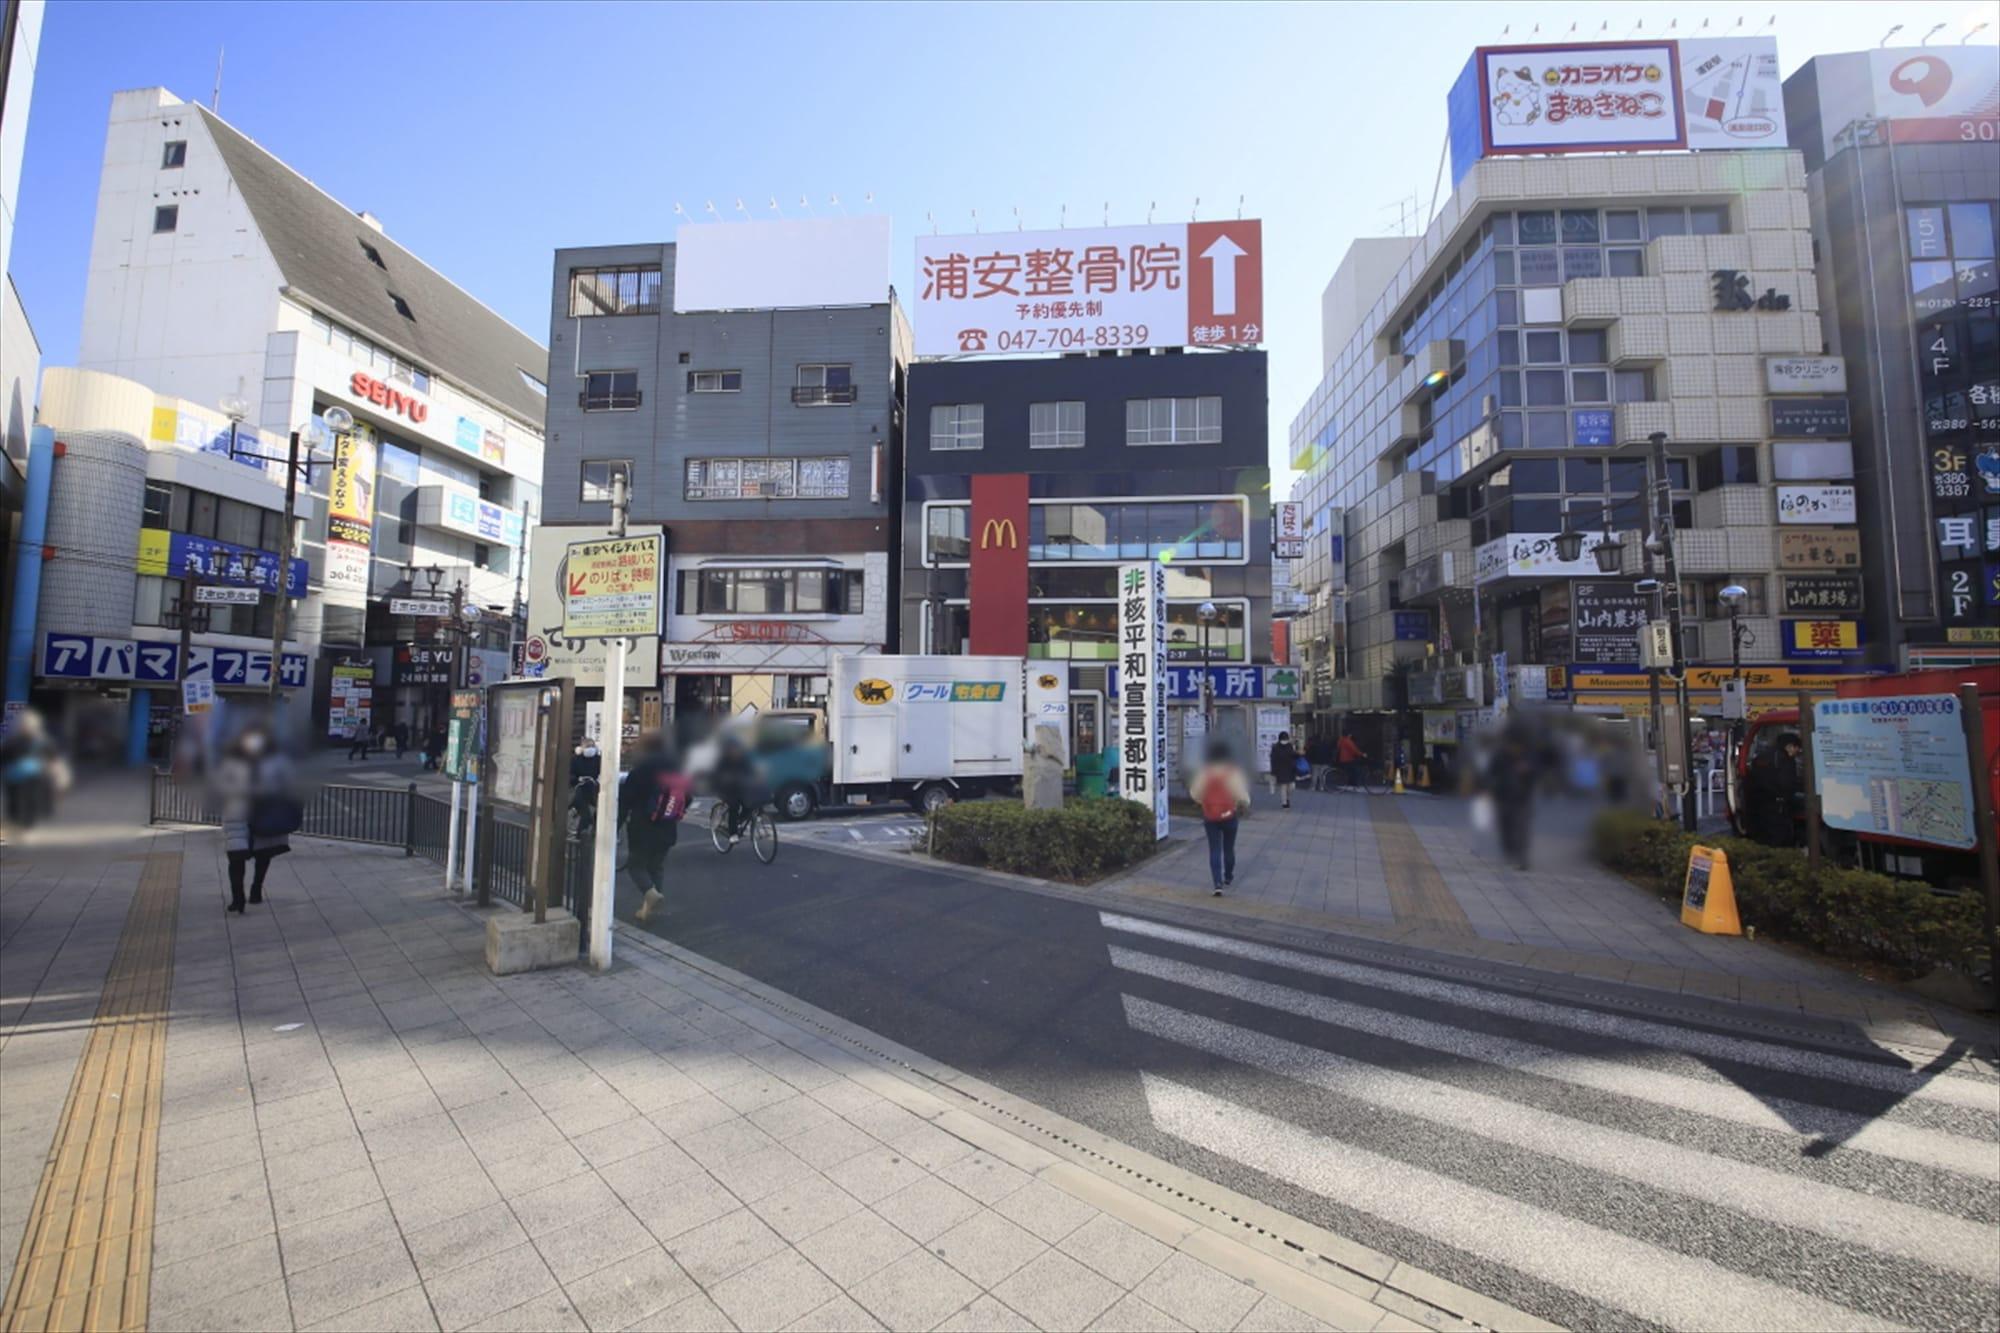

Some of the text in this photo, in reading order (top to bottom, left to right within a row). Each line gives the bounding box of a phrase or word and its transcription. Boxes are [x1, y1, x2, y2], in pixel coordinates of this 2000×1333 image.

[1559, 65, 1644, 84] カラオケ
[1547, 92, 1664, 124] まねきねこ
[922, 242, 1181, 301] 浦安整骨院
[1016, 300, 1103, 320] 予約優先制
[998, 325, 1148, 351] 047-704-8339
[1193, 326, 1260, 342] 徒歩1分
[350, 372, 428, 423] SEIYU
[1934, 450, 1967, 471] 3F
[1936, 485, 1970, 496] 3387
[1952, 571, 1972, 616] 2F
[732, 622, 787, 640] SLOT
[1810, 623, 1841, 646] 薬
[52, 640, 305, 684] アパマンプラザ
[411, 651, 453, 663] SEYU
[1124, 568, 1147, 793] 非核平和宣言都市
[908, 684, 1000, 699] クール 宅急便
[1042, 703, 1066, 712] クール
